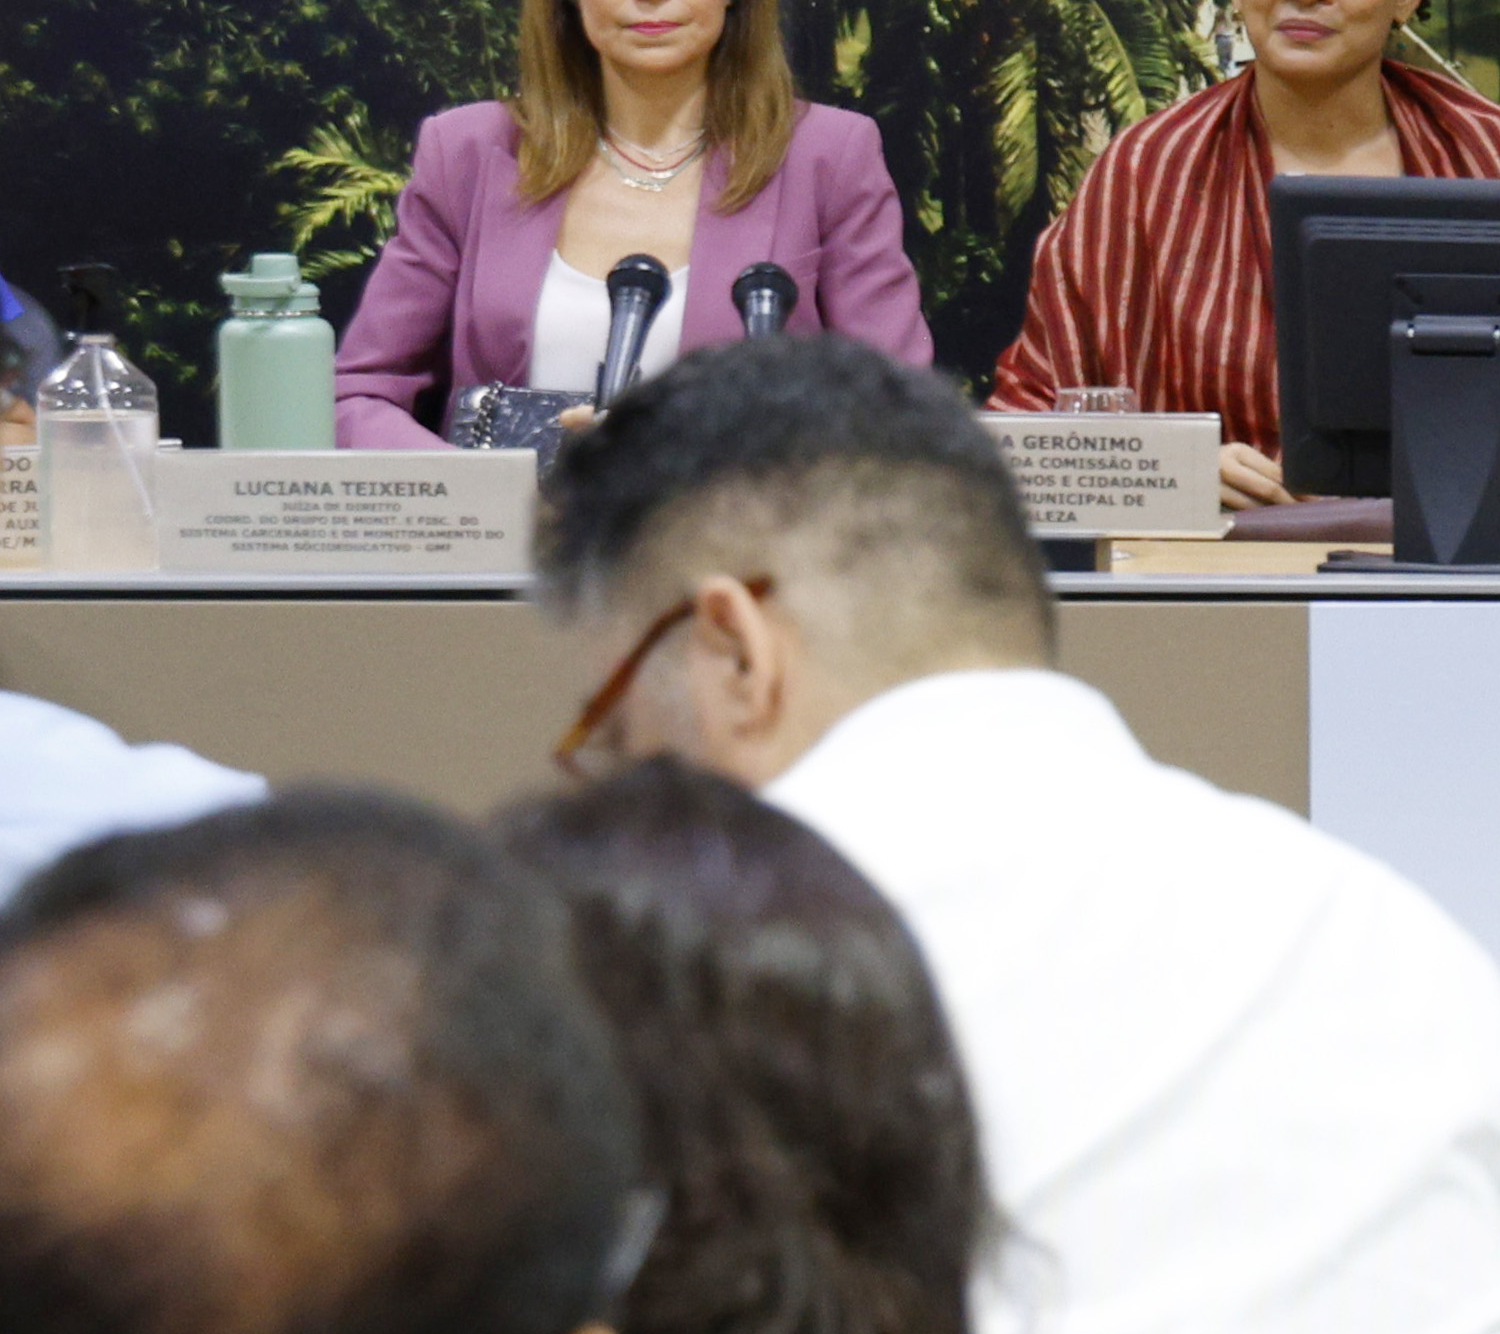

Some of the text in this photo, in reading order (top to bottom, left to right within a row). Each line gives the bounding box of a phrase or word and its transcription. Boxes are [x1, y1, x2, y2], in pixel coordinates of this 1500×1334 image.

[1040, 455, 1132, 471] COMISSÃO
[1138, 460, 1160, 472] DE
[234, 480, 448, 497] LUCIANA TEIXEIRA
[1020, 475, 1178, 489] NOS E CIDADANIA
[1123, 495, 1145, 506] DE
